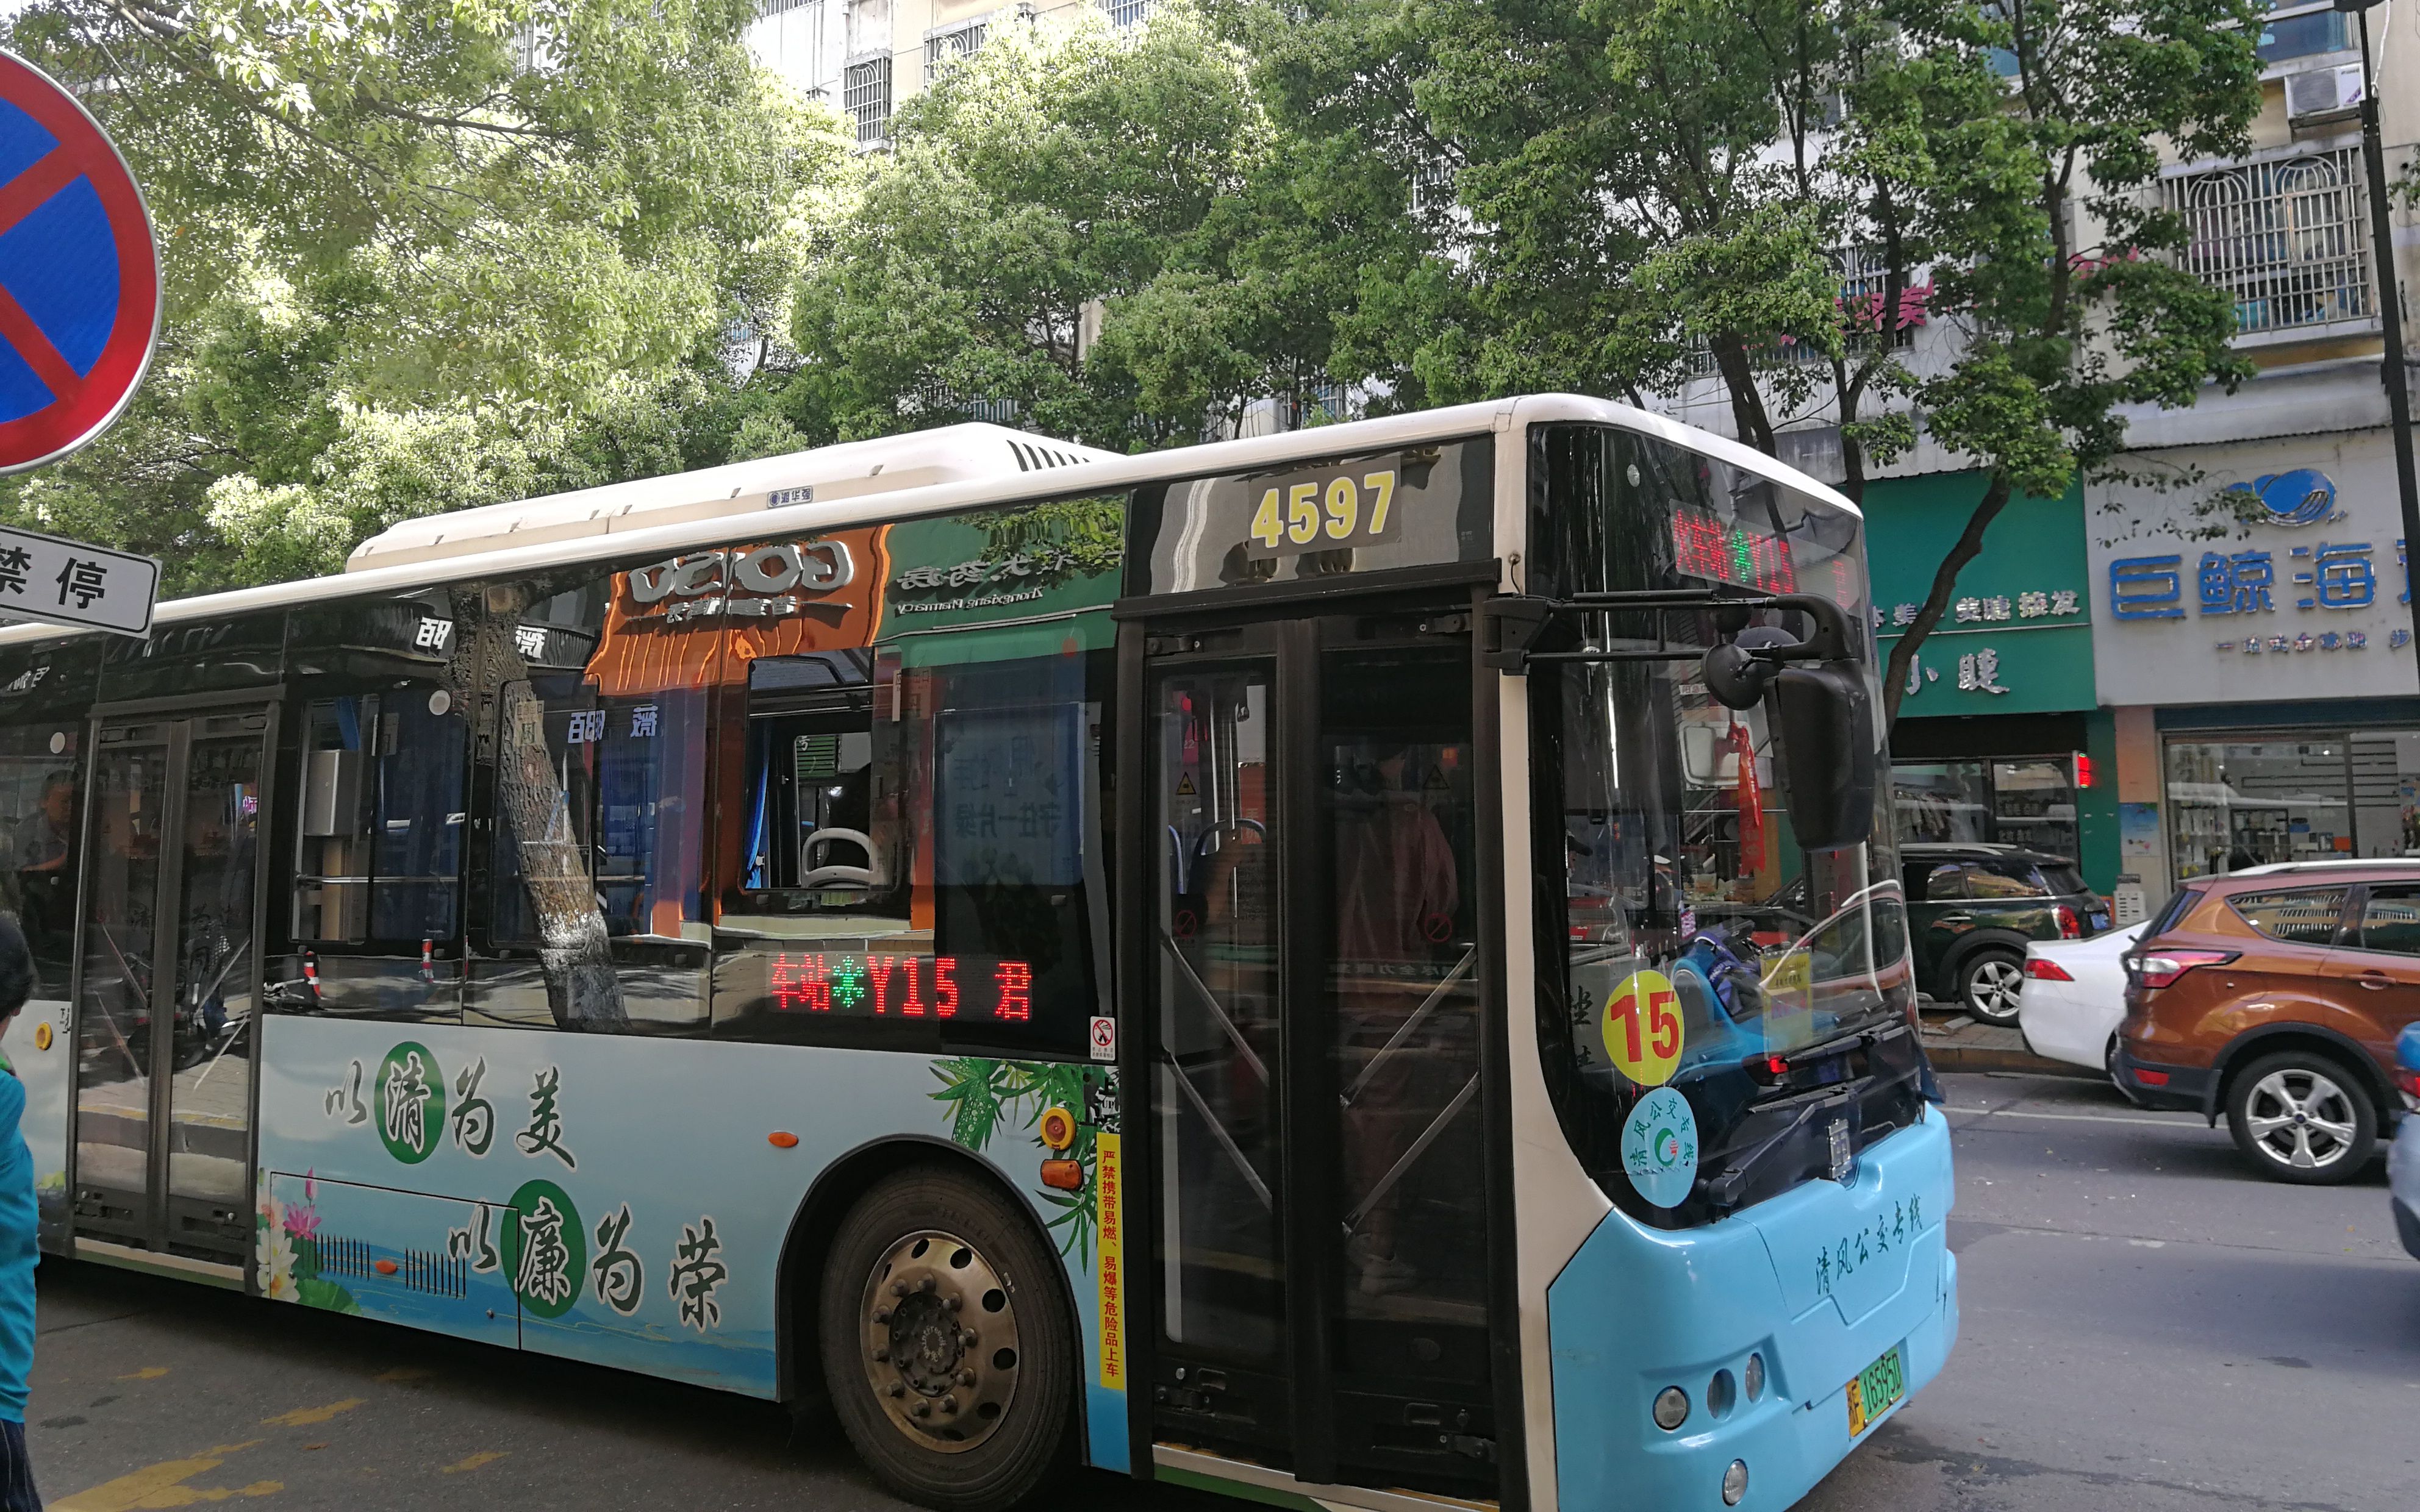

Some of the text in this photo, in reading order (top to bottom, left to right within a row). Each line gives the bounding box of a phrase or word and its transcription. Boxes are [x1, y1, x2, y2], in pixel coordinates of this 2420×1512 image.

[1250, 469, 1396, 549] 4597
[0, 546, 107, 610] 禁停
[867, 956, 958, 1017] Y15
[1610, 991, 1680, 1063] 15
[326, 1051, 578, 1172] 以清为美
[448, 1196, 729, 1333] 以廉为荣
